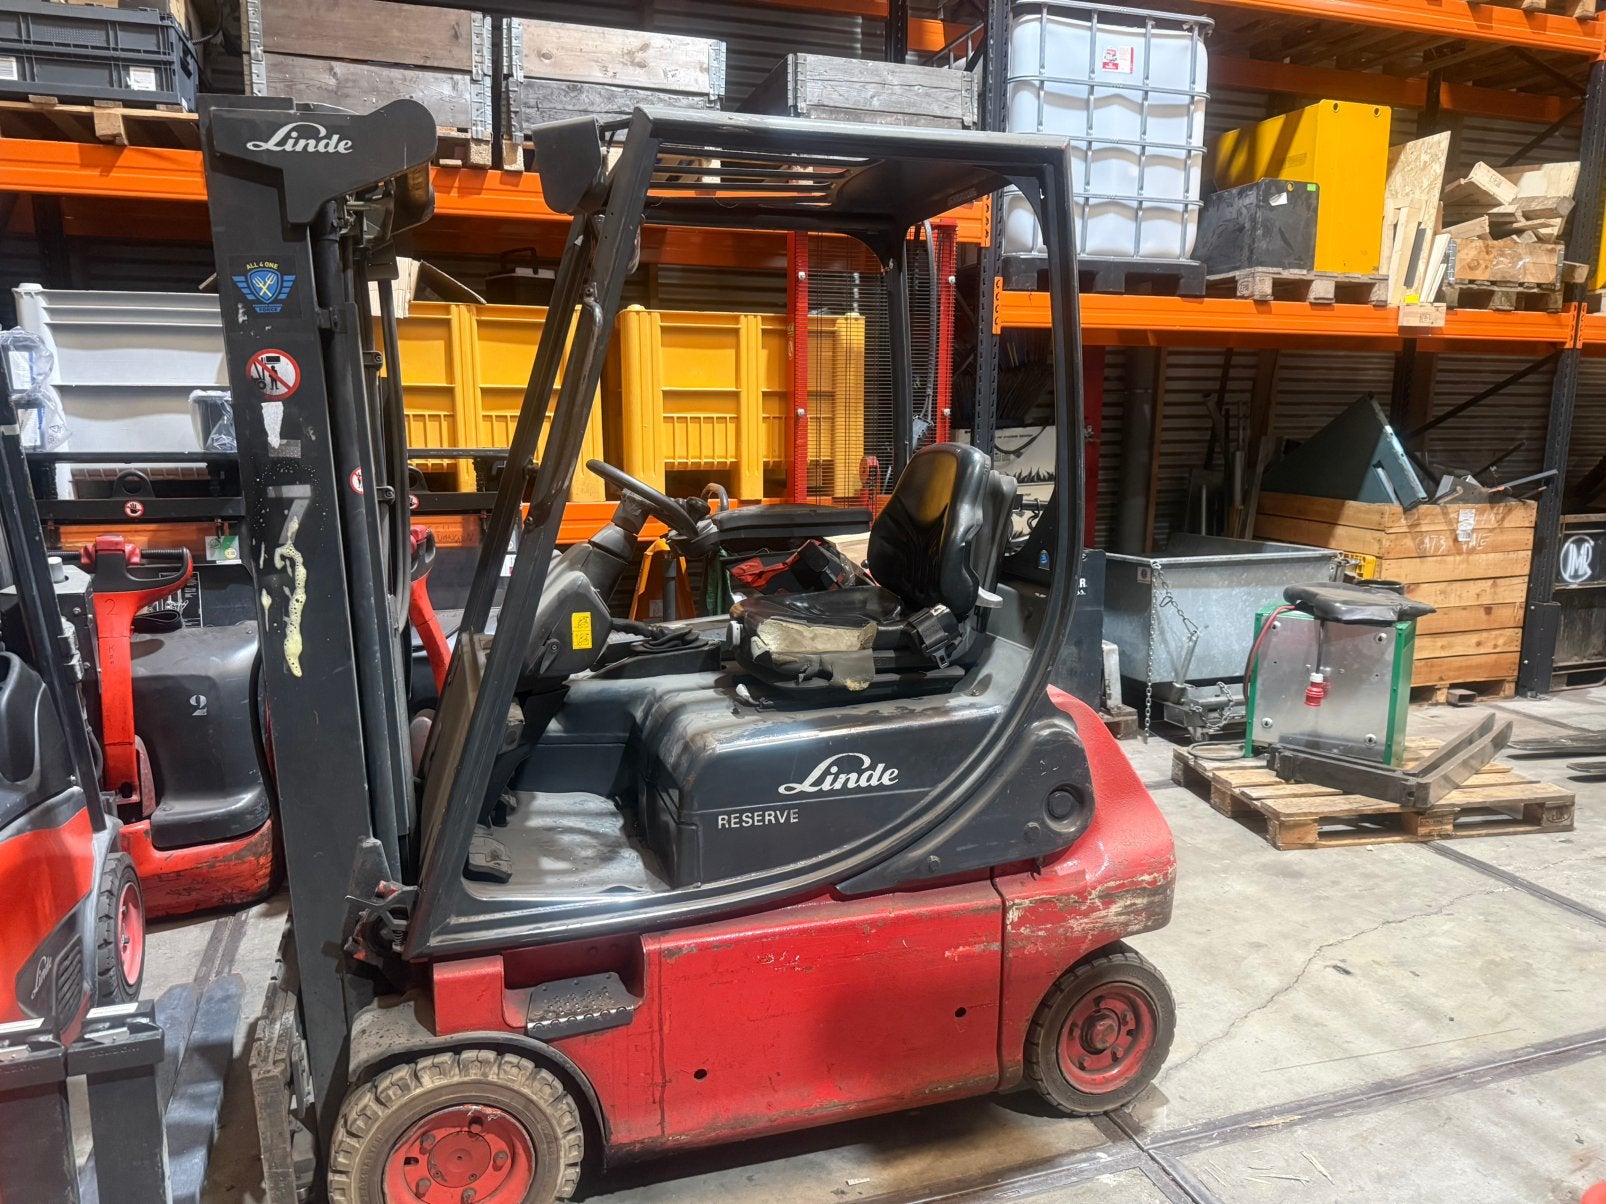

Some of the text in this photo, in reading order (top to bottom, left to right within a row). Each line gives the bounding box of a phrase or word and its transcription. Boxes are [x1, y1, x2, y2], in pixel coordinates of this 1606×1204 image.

[246, 122, 353, 154] Linde
[246, 262, 258, 270] ALL
[264, 261, 279, 269] ONE
[189, 694, 208, 716] 2
[777, 752, 899, 795] Linde
[717, 809, 799, 829] RESERVE
